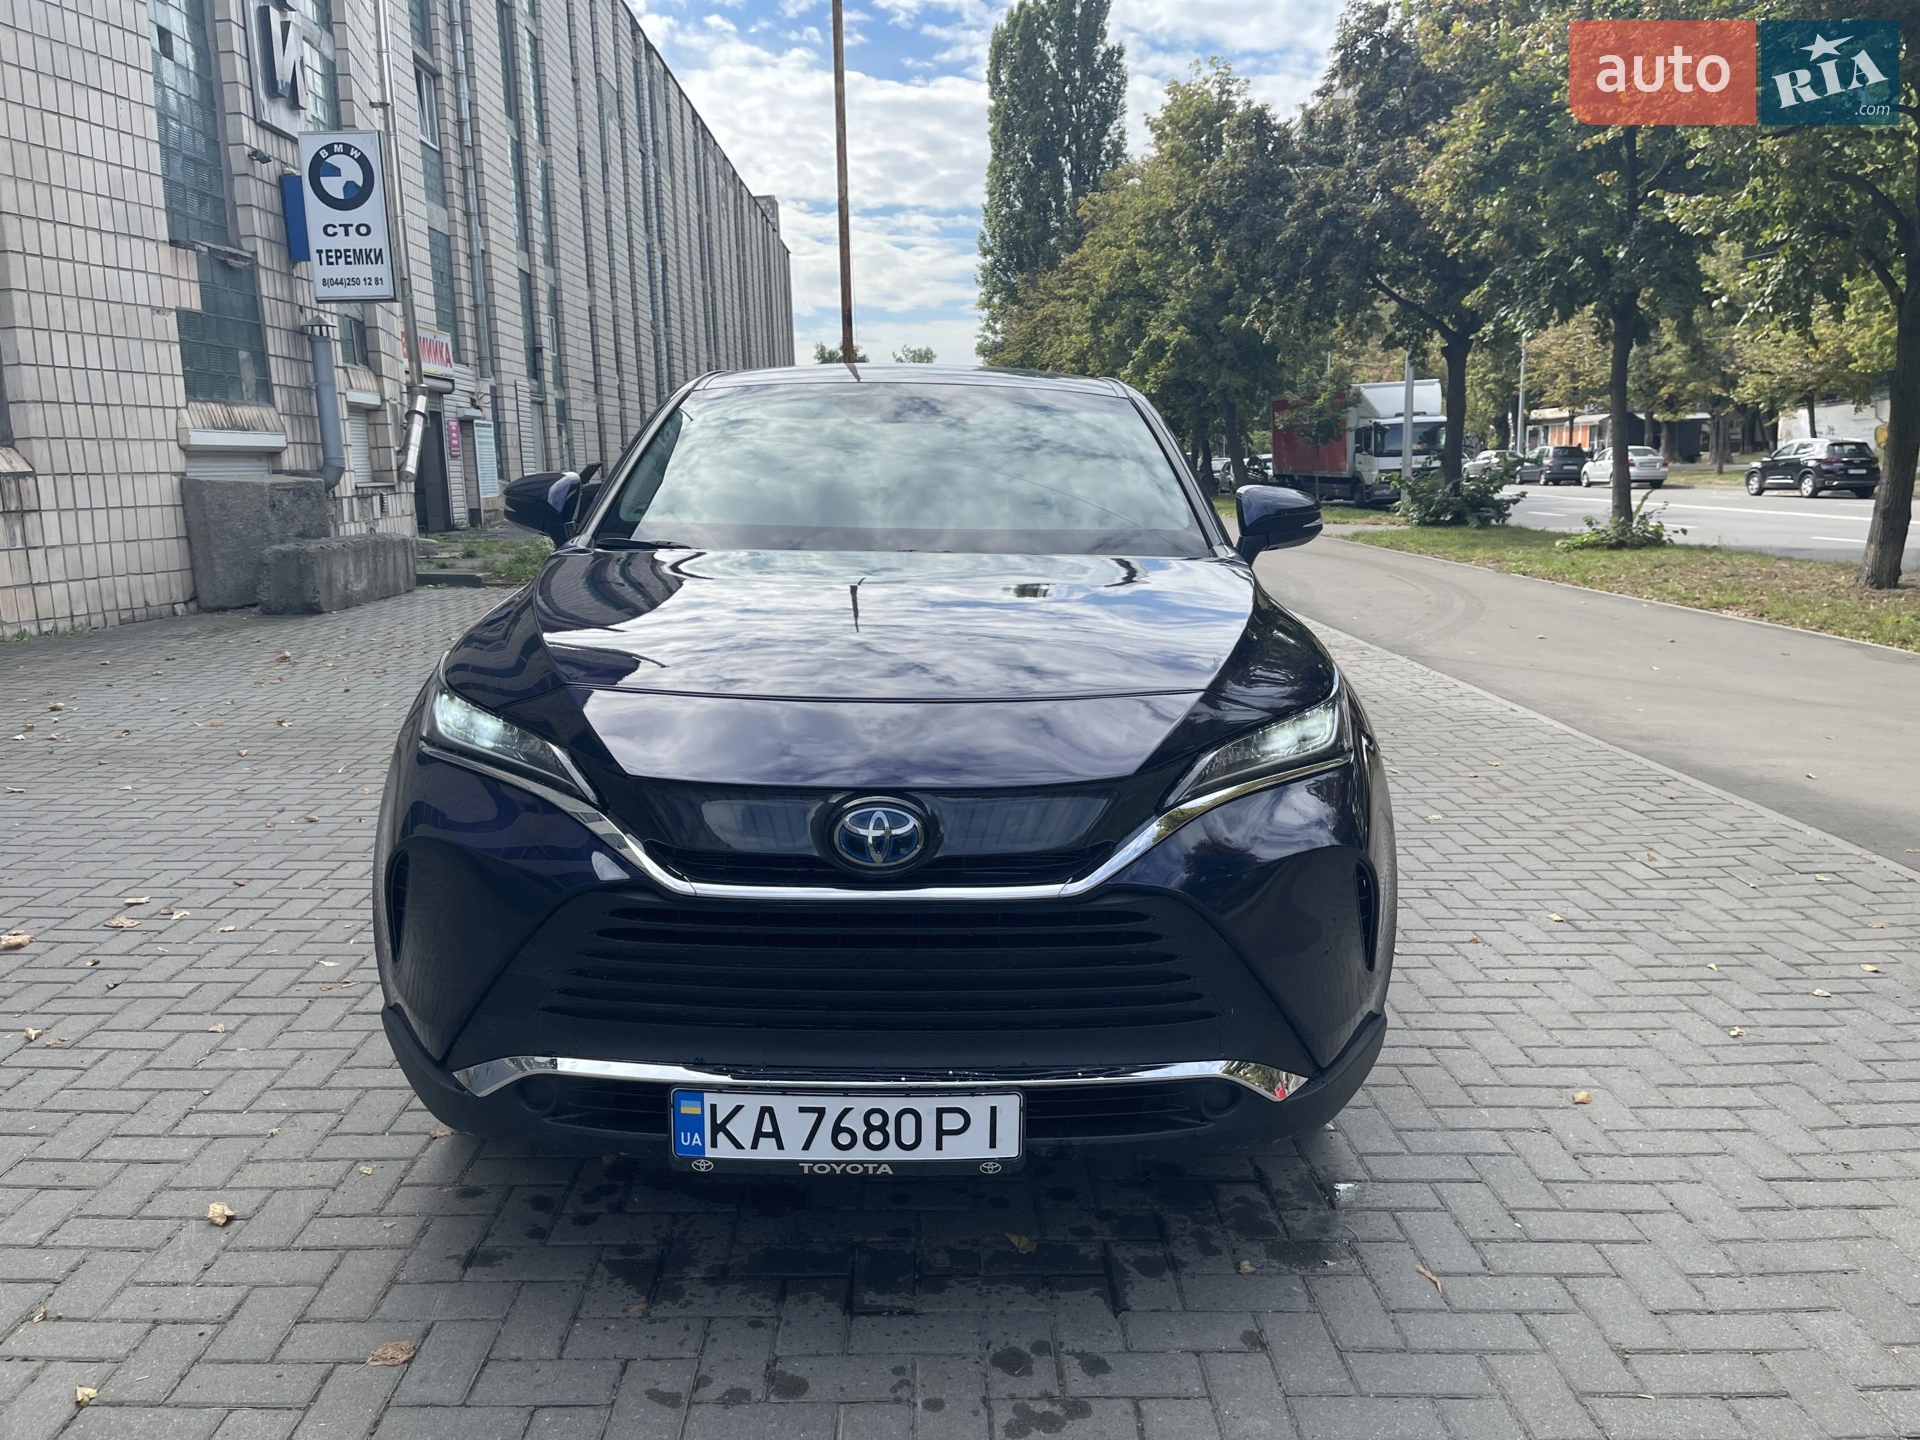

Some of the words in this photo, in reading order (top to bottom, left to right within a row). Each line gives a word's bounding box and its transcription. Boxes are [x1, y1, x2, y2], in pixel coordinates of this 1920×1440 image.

[257, 0, 307, 110] И
[319, 144, 361, 159] BMW
[322, 223, 372, 237] СТО
[316, 248, 384, 266] ТЕРЕМКИ
[322, 277, 361, 288] 8(044)250
[363, 277, 373, 286] 12
[374, 277, 384, 286] 81
[680, 1132, 702, 1147] UA
[799, 1163, 894, 1175] TOYOTA
